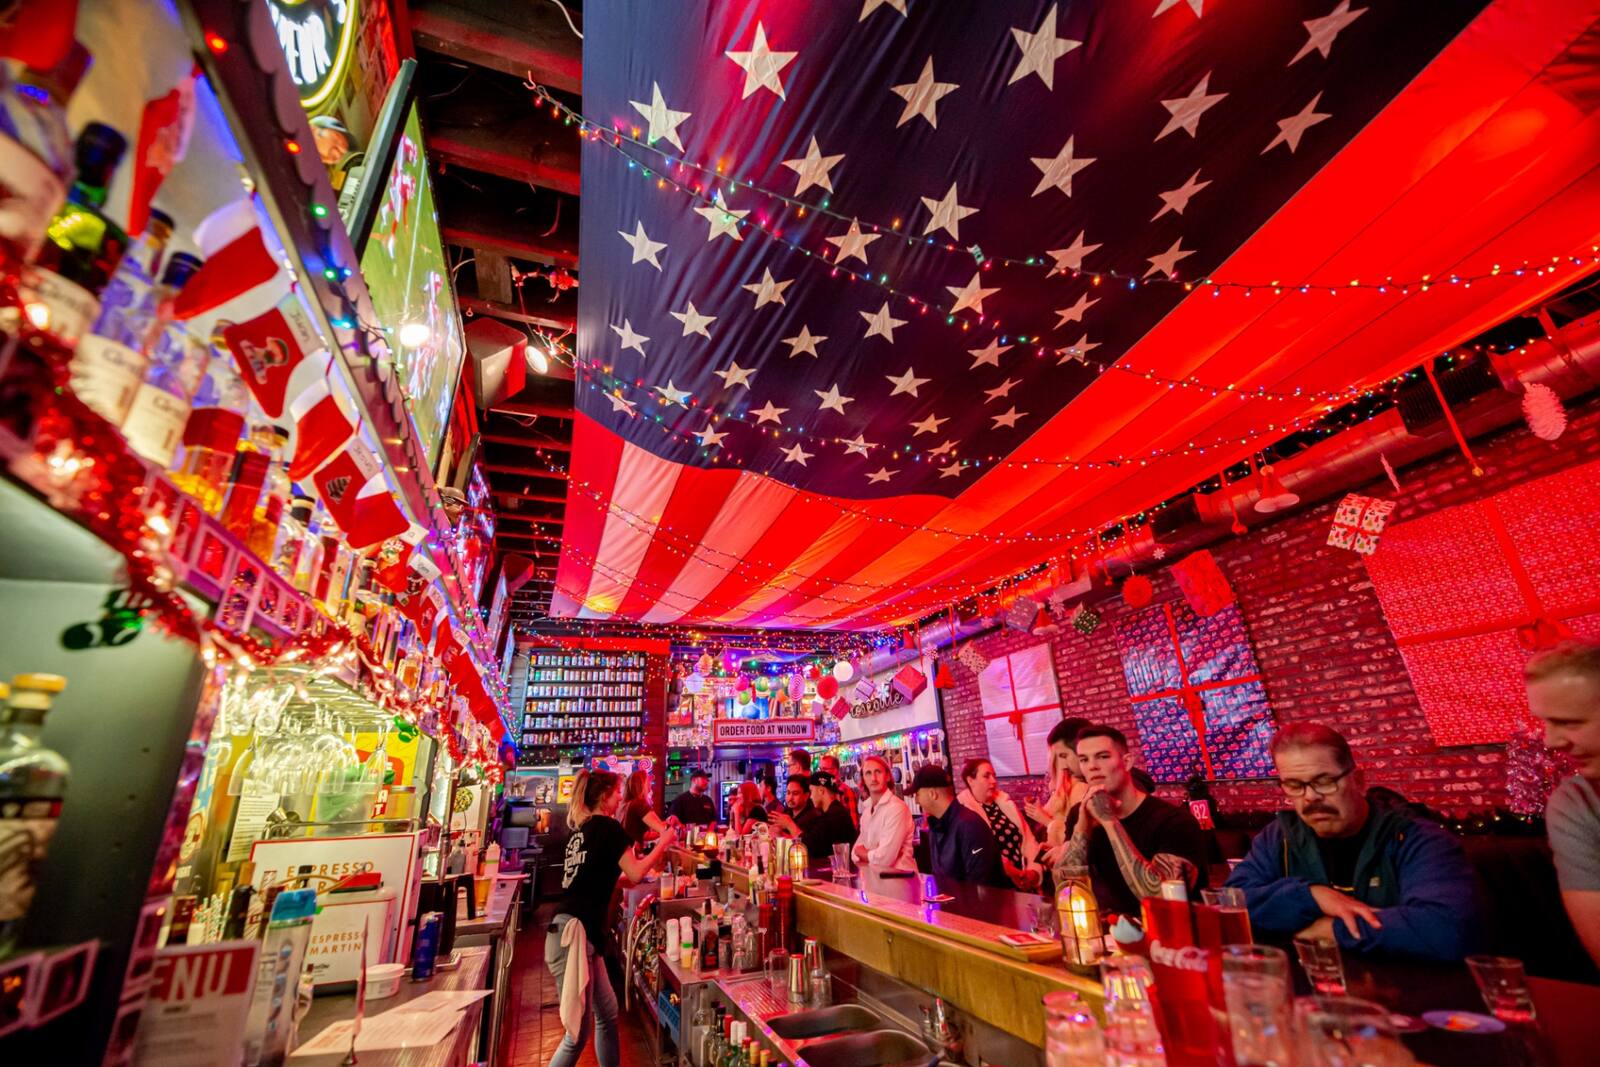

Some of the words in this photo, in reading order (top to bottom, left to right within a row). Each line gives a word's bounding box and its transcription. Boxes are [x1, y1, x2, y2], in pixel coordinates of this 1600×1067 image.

[720, 725, 745, 736] ORDER
[746, 725, 766, 736] FOOD
[767, 725, 776, 734] AT
[777, 724, 807, 734] WINDOW
[1192, 803, 1209, 820] 82
[287, 861, 375, 878] EPRESSO
[311, 931, 365, 945] ESPRESS
[308, 942, 362, 956] MARTIN
